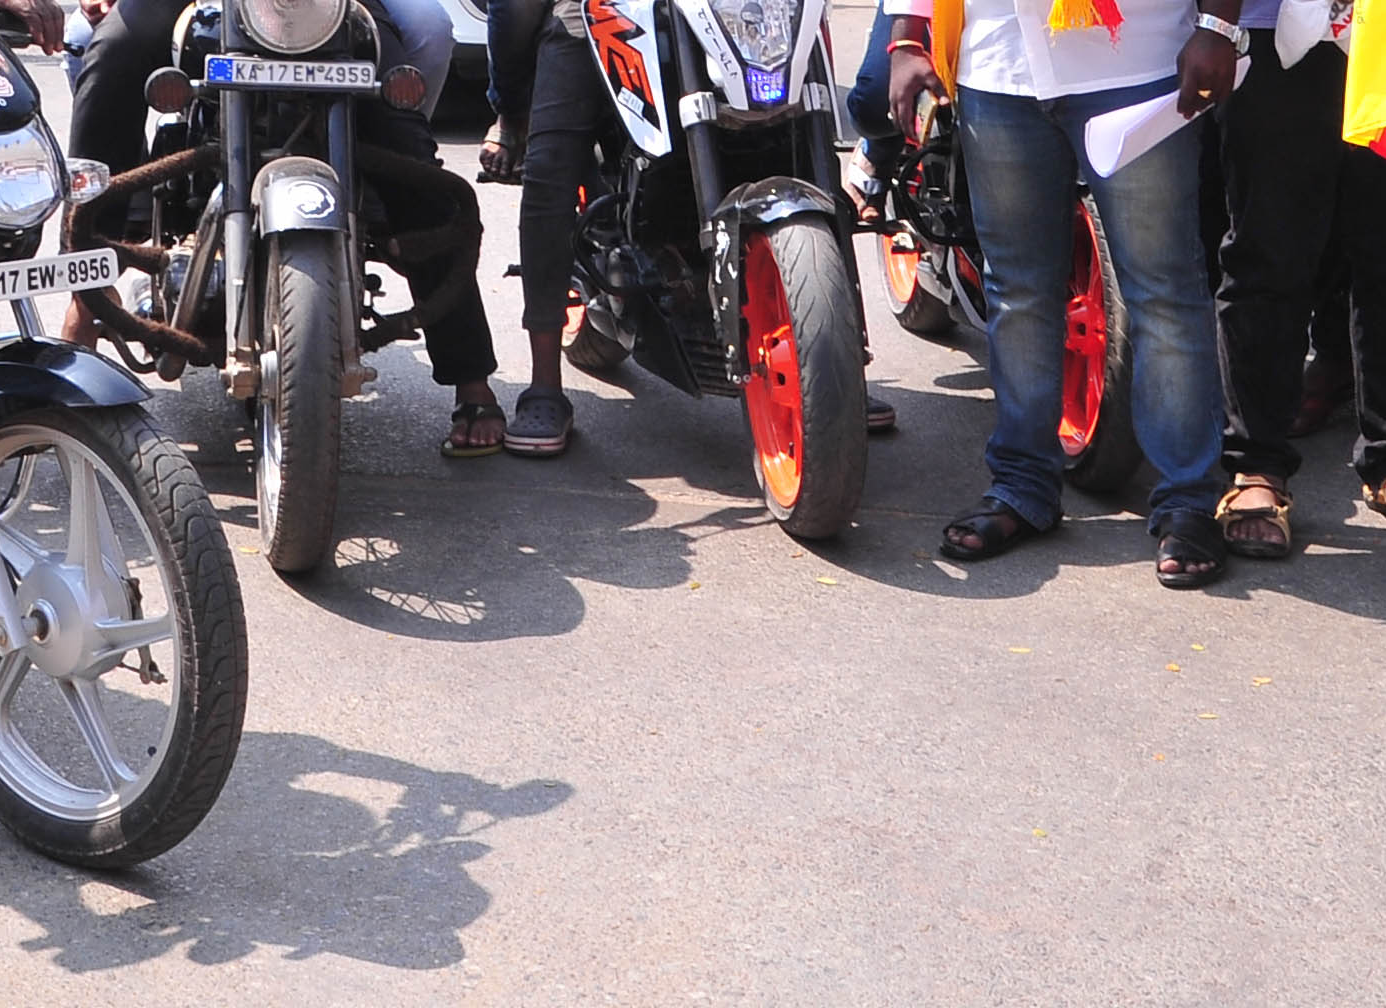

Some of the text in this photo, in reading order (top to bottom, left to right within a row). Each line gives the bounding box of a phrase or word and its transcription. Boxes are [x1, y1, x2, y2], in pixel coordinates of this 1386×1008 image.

[235, 61, 259, 82] KA
[268, 63, 289, 83] 17
[323, 65, 372, 85] 4959
[27, 264, 57, 291] EW
[68, 256, 111, 285] 8956
